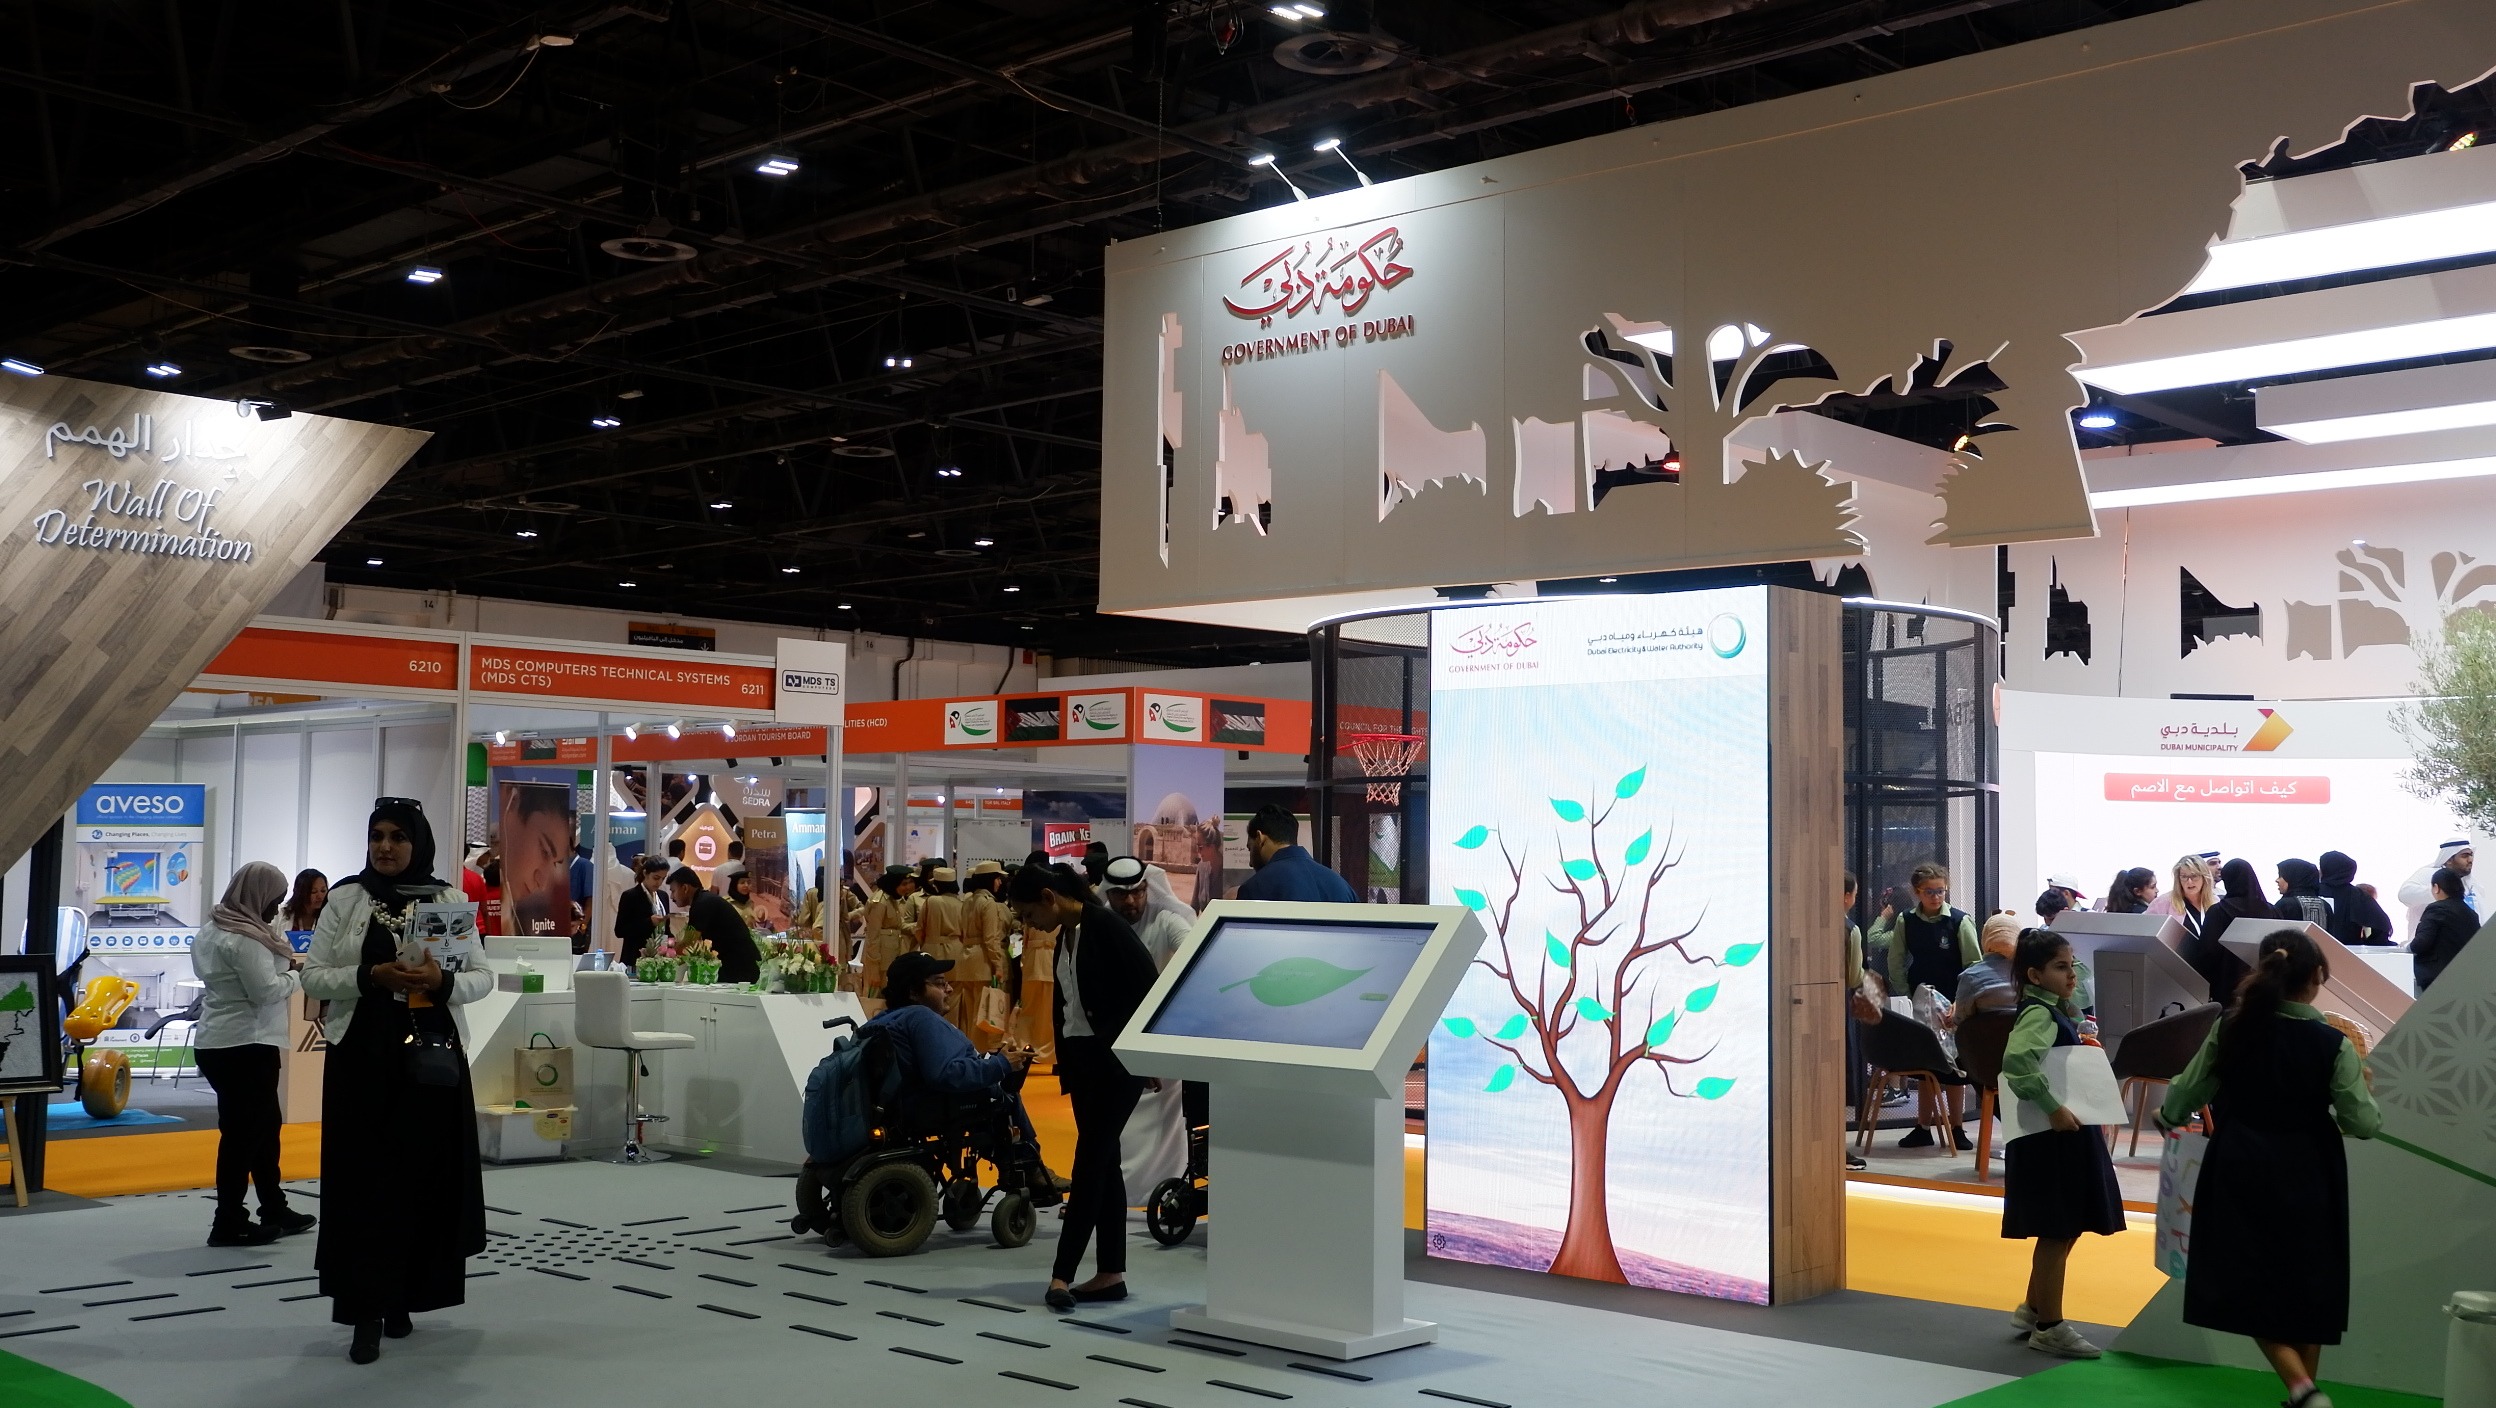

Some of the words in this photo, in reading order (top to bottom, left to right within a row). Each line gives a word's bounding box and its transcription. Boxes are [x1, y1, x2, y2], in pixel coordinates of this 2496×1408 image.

[1222, 329, 1330, 363] GOVERNMENT
[1335, 323, 1357, 346] OF
[1363, 315, 1414, 342] DUBAI
[45, 413, 151, 459] الهمم
[83, 478, 176, 523] Wall
[174, 486, 225, 535] Of
[33, 508, 253, 562] Determination
[424, 599, 435, 609] 14
[865, 640, 874, 649] 16
[1587, 647, 1607, 656] Dubai
[1608, 645, 1641, 655] Electricity
[1646, 644, 1668, 653] Water
[1669, 642, 1704, 651] Authority
[408, 659, 442, 674] 6210
[481, 657, 511, 671] MDS
[515, 660, 597, 677] COMPUTERS
[601, 666, 673, 682] TECHNICAL
[677, 671, 731, 686] SYSTEMS
[1449, 663, 1501, 674] GOVERNMENT
[1503, 662, 1514, 672] OF
[1516, 660, 1539, 670] DUBAI
[481, 671, 516, 685] (MDS
[520, 674, 552, 688] CTS)
[803, 675, 822, 686] MDS
[825, 677, 836, 687] TS
[741, 683, 765, 695] 6211
[866, 717, 888, 728] (HCD)
[2190, 721, 2239, 738] بلدية
[731, 733, 757, 743] ORDAN
[758, 731, 787, 741] TOURISM
[787, 731, 811, 740] BOARD
[2160, 724, 2189, 739] دبي
[2160, 743, 2184, 751] DUBAI
[2185, 743, 2239, 752] MUNICIPALITY
[2131, 778, 2169, 799] الاصم
[2173, 784, 2196, 801] مع
[2200, 779, 2254, 796] اتواصل
[2259, 780, 2298, 799] كيف
[95, 794, 185, 815] aveso
[742, 796, 771, 807] SEDRA
[105, 831, 131, 839] Changing
[751, 828, 777, 839] Petra
[792, 822, 826, 834] Amman
[1049, 830, 1076, 848] BRAIN
[531, 917, 556, 934] Ignite
